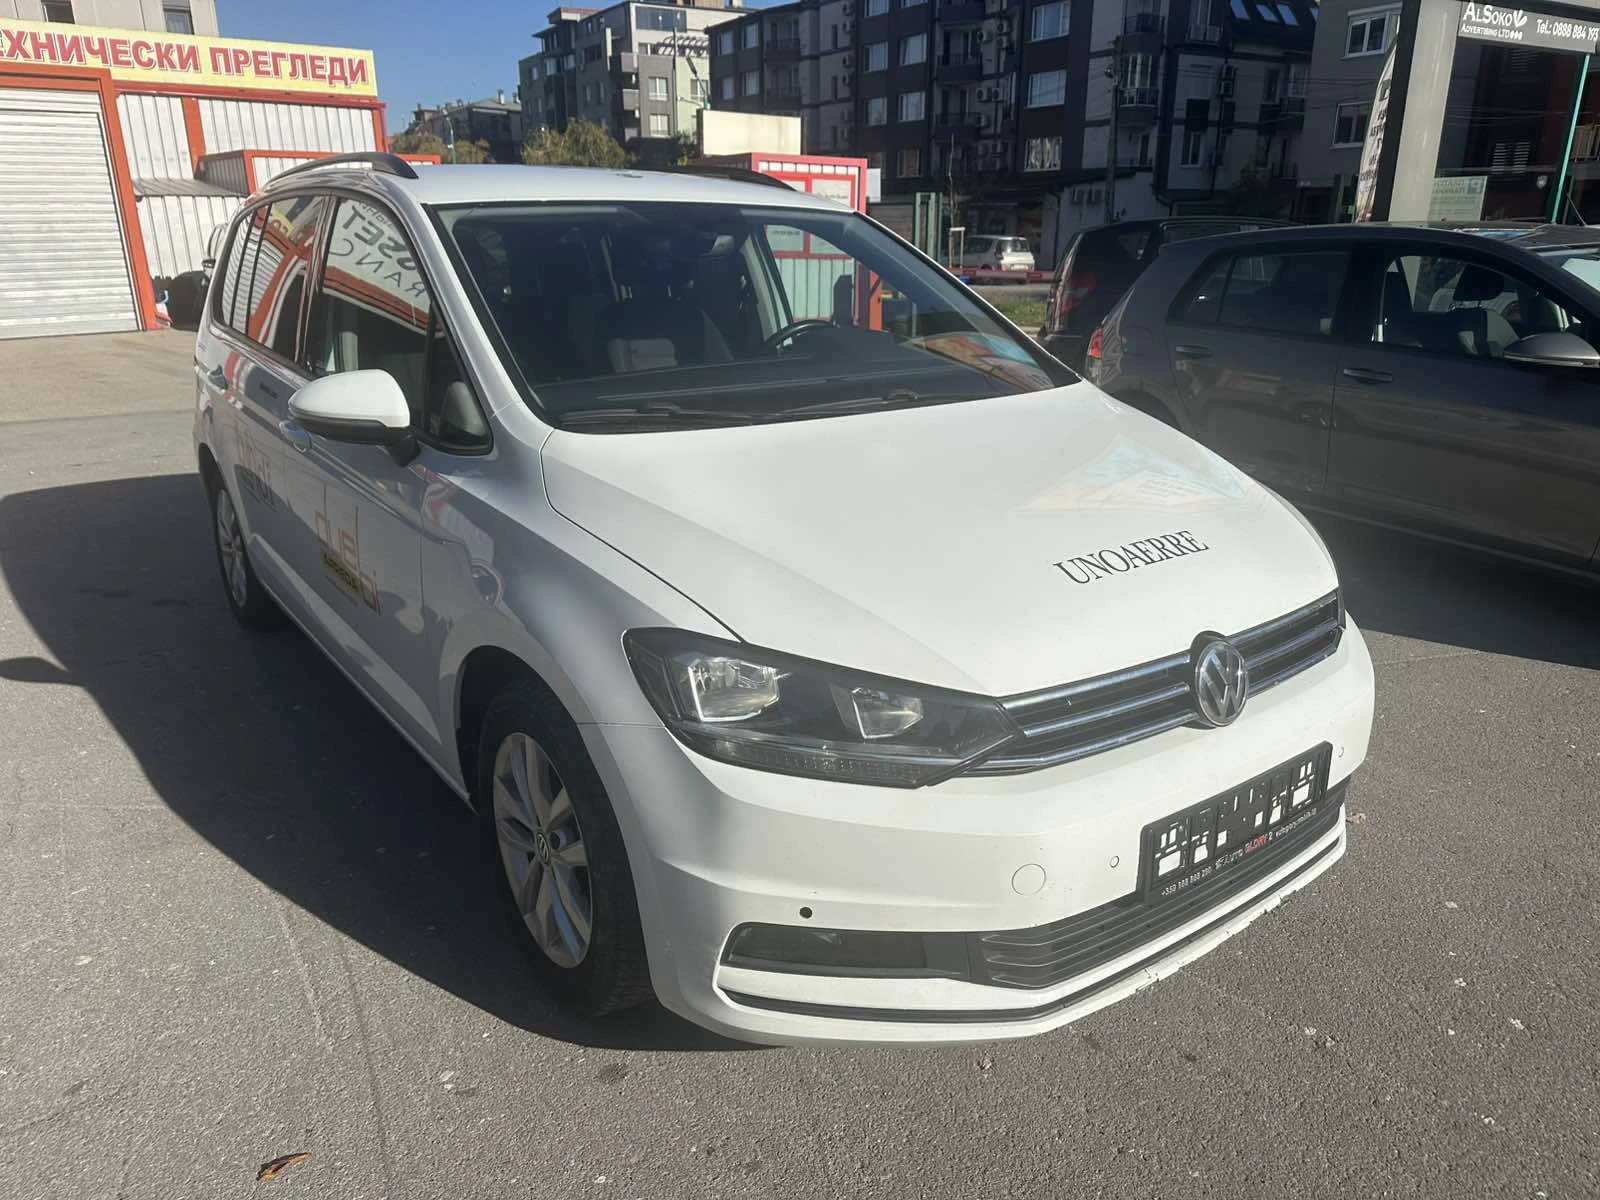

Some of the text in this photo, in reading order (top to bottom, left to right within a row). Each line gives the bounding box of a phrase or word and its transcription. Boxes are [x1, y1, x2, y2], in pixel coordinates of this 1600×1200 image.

[1498, 28, 1510, 39] LTD
[1552, 21, 1572, 38] 0888
[1572, 24, 1586, 39] 884
[1587, 27, 1600, 42] 193
[0, 29, 368, 87] ХНИЧЕСКИ ПРЕГЛЕДИ
[1053, 530, 1209, 584] UNOAERRE
